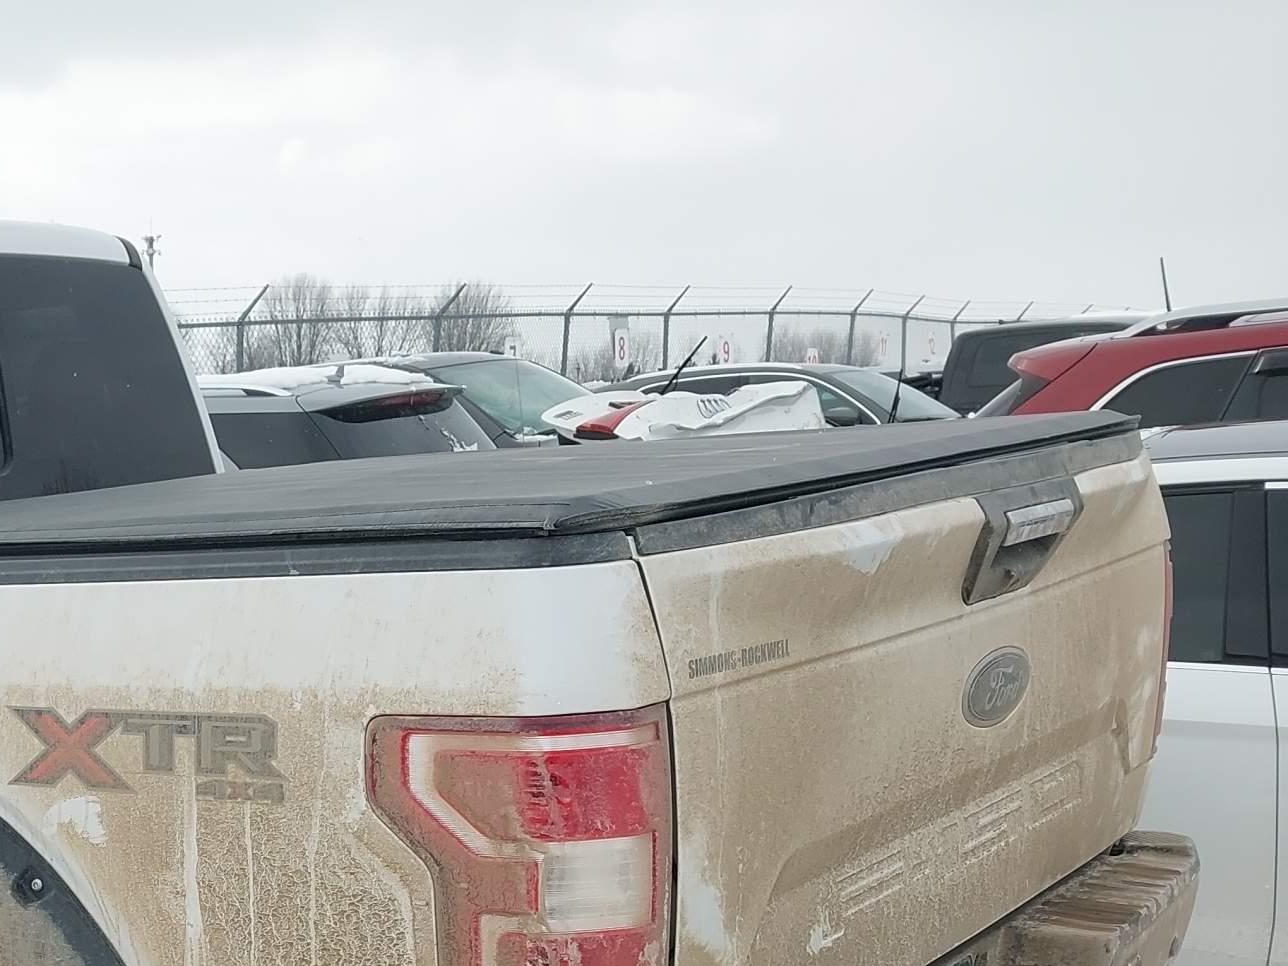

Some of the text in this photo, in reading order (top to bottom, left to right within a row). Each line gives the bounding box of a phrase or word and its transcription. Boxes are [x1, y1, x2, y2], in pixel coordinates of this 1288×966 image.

[618, 336, 625, 360] 8
[723, 341, 730, 362] 9
[984, 664, 1024, 711] Ford
[6, 704, 290, 794] XTR
